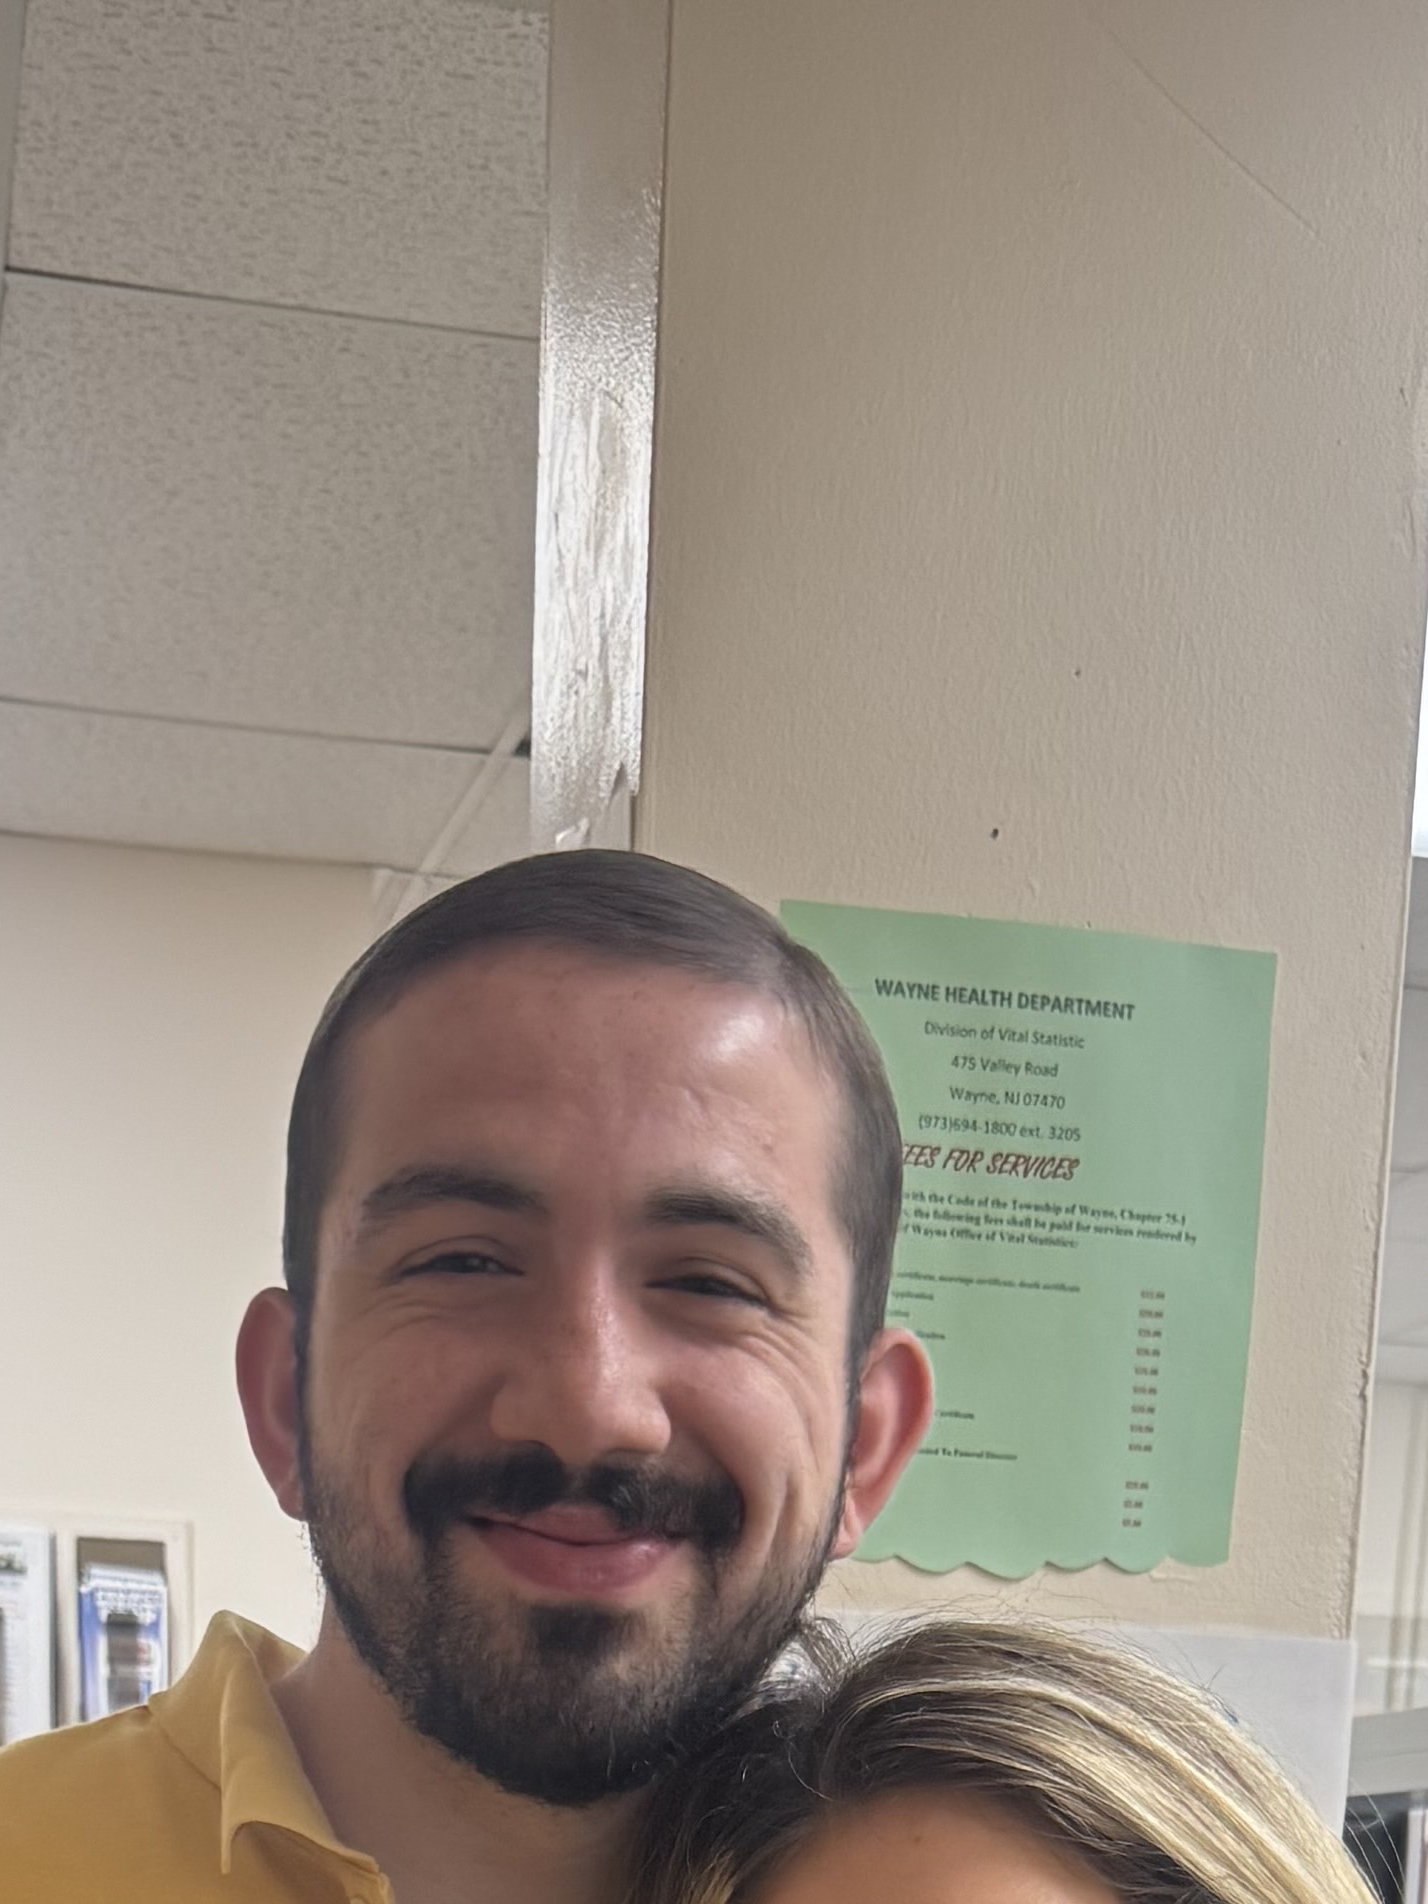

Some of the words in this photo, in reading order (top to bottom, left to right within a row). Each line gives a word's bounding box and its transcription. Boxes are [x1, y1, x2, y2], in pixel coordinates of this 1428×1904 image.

[875, 978, 940, 1001] WAYNE
[945, 986, 1013, 1009] HEALTH
[1017, 992, 1135, 1020] DEPARTMENT
[924, 1021, 976, 1039] Division
[981, 1025, 995, 1040] of
[998, 1027, 1029, 1043] Vital
[951, 1055, 976, 1071] 475
[980, 1057, 1021, 1077] Valley
[1025, 1061, 1059, 1077] Road
[949, 1086, 1001, 1105] Wayne,
[1004, 1091, 1020, 1106] NJ
[1022, 1091, 1065, 1109] 07470
[1047, 1127, 1081, 1142] 3205
[903, 1143, 941, 1168] EES
[942, 1148, 984, 1174] FOR
[986, 1152, 1081, 1180] SERVICES
